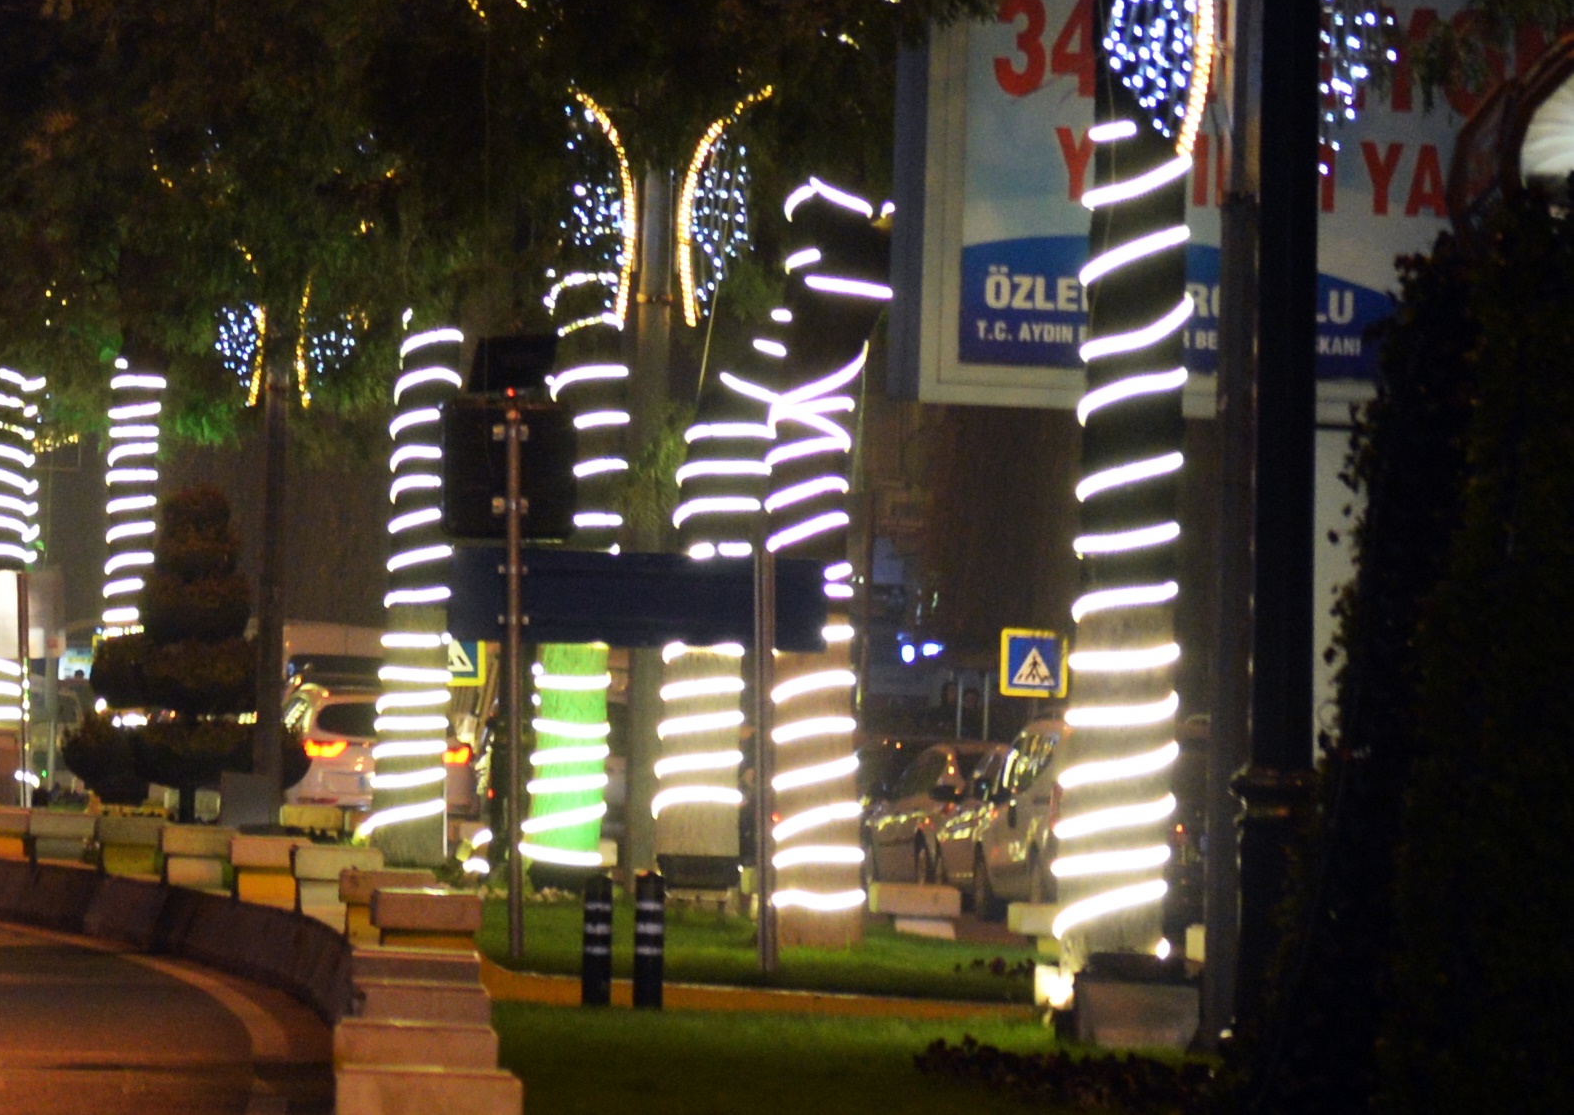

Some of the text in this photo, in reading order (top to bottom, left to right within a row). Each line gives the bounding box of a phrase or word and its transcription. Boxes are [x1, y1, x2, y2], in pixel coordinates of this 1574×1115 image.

[985, 265, 1088, 312] ÖZLE
[977, 320, 1013, 342] T.C.
[1018, 321, 1074, 344] AYDIN
